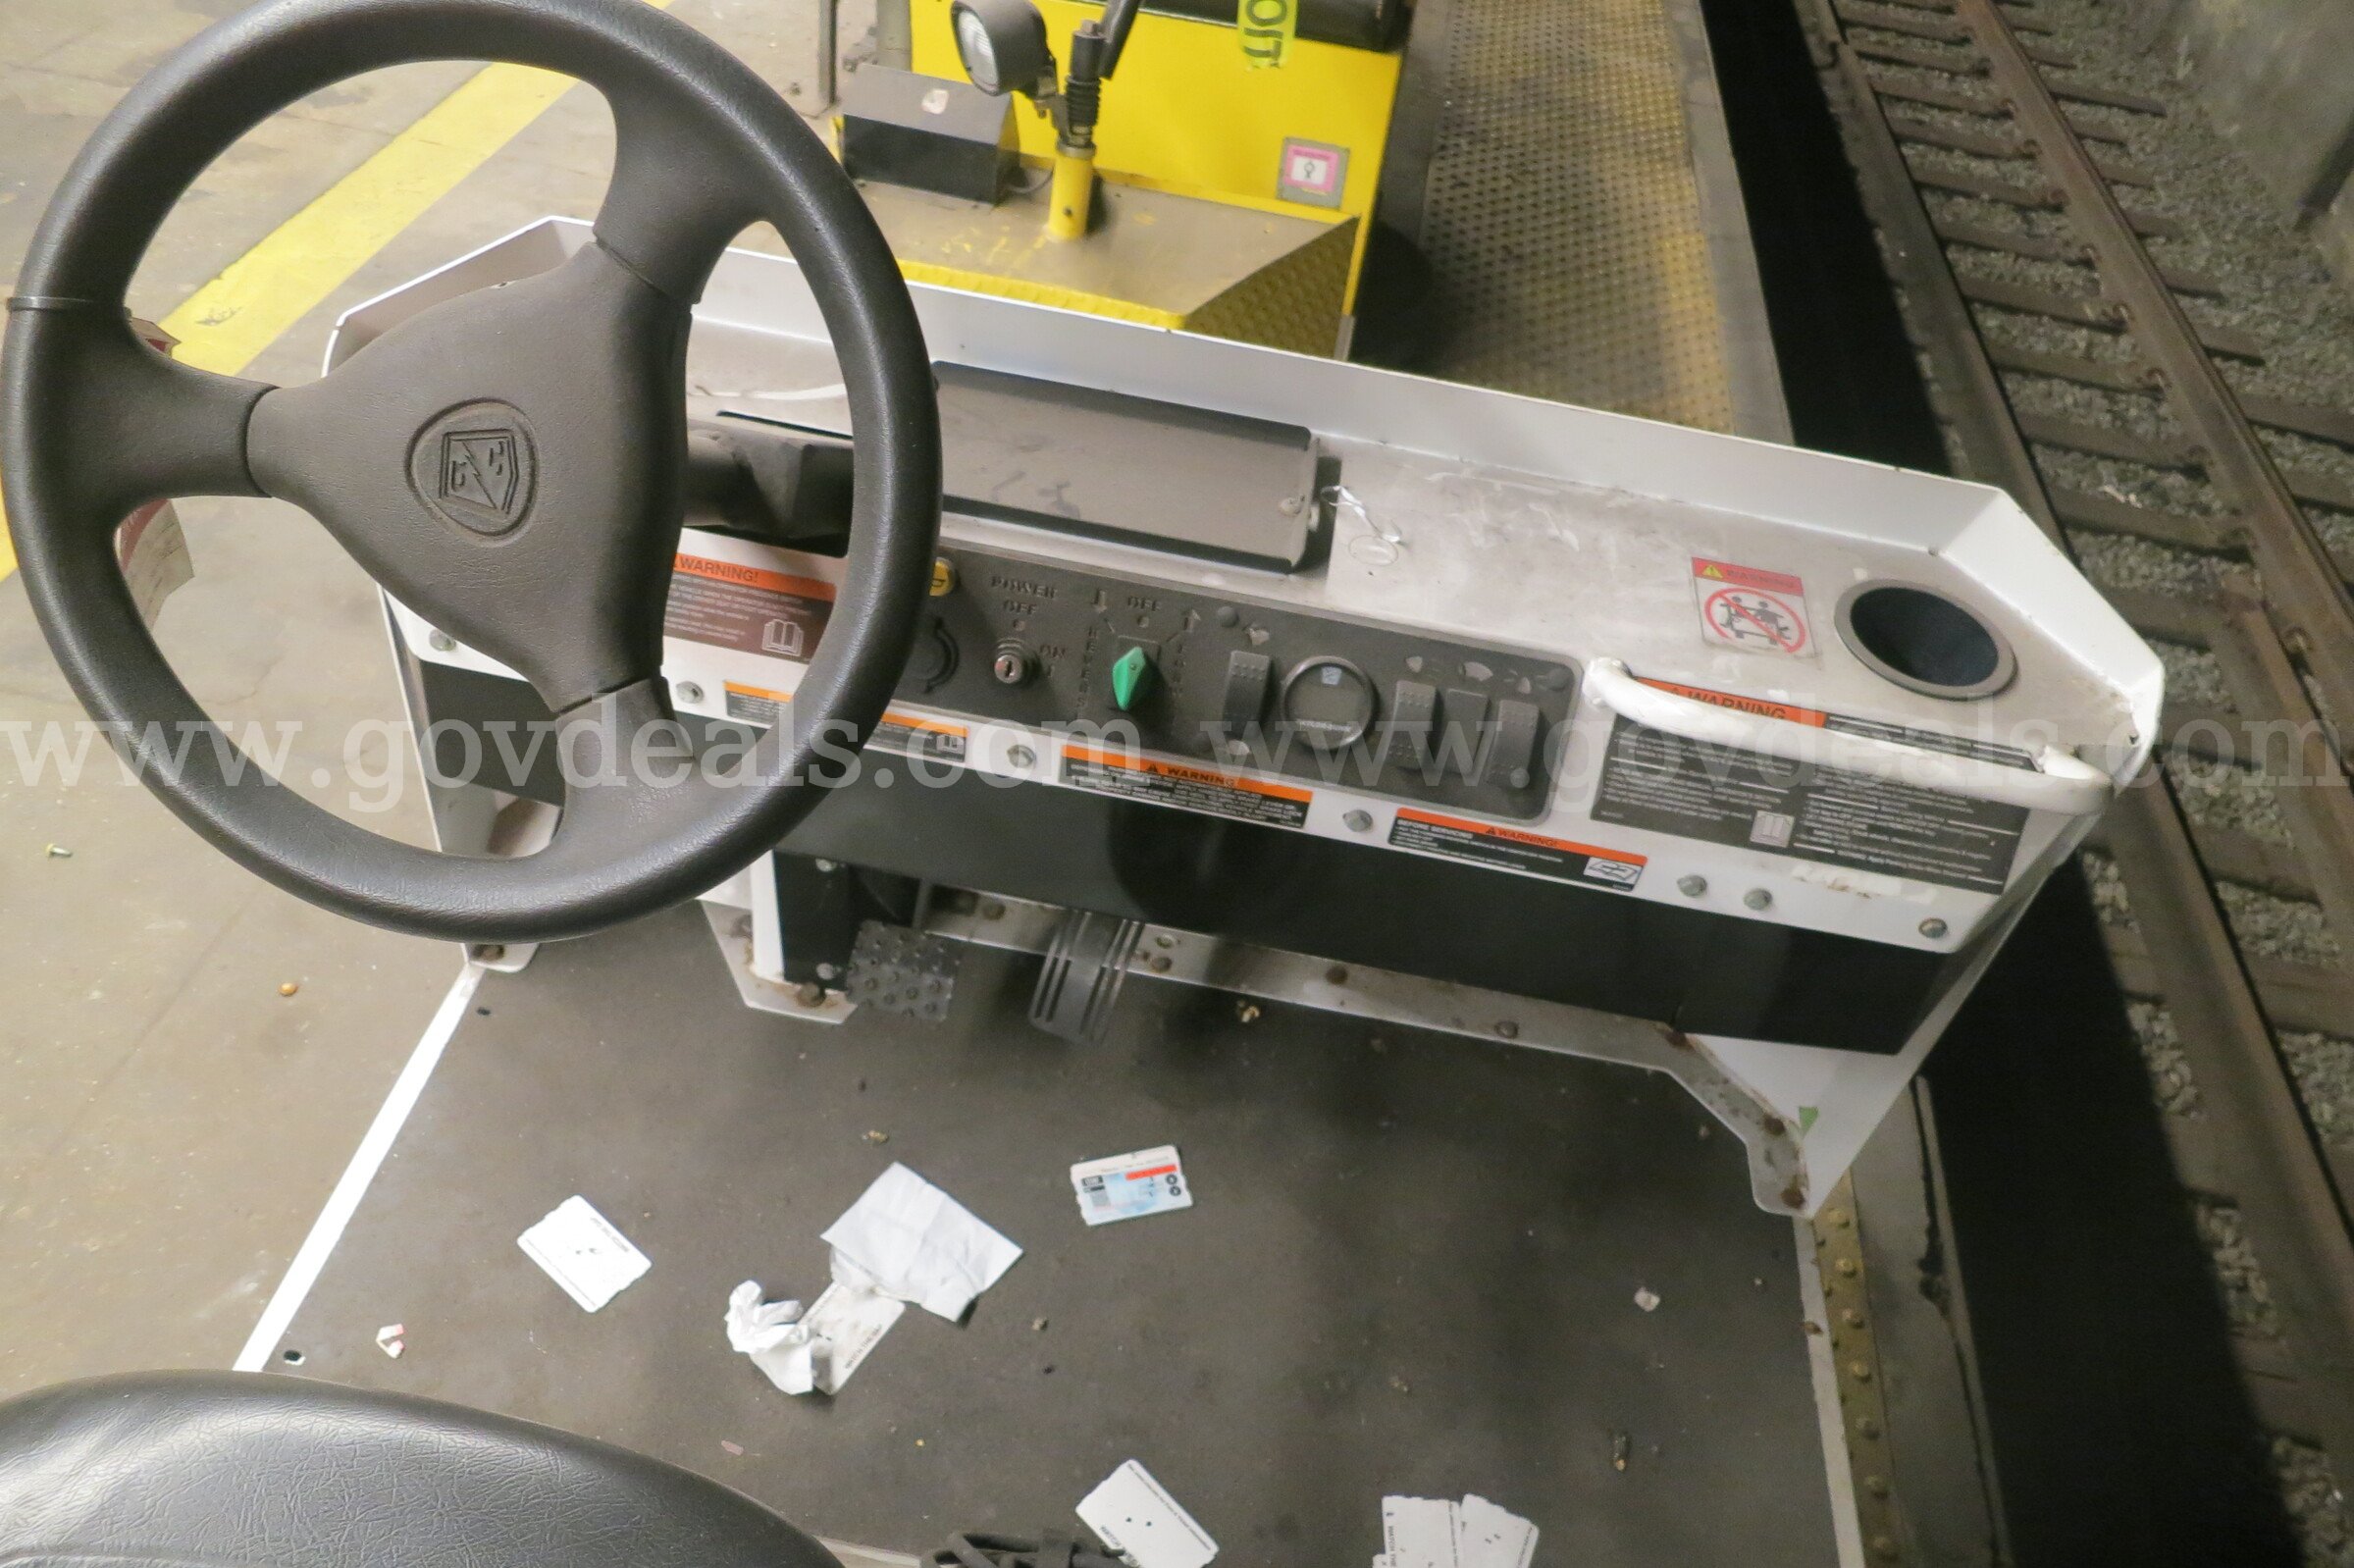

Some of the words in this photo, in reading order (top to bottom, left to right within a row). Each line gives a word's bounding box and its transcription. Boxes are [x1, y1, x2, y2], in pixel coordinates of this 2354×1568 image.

[678, 557, 759, 583] WARNING!
[991, 575, 1058, 600] POWER
[1003, 599, 1037, 616] OFF
[1126, 595, 1162, 612] OFF
[1039, 644, 1067, 659] ON
